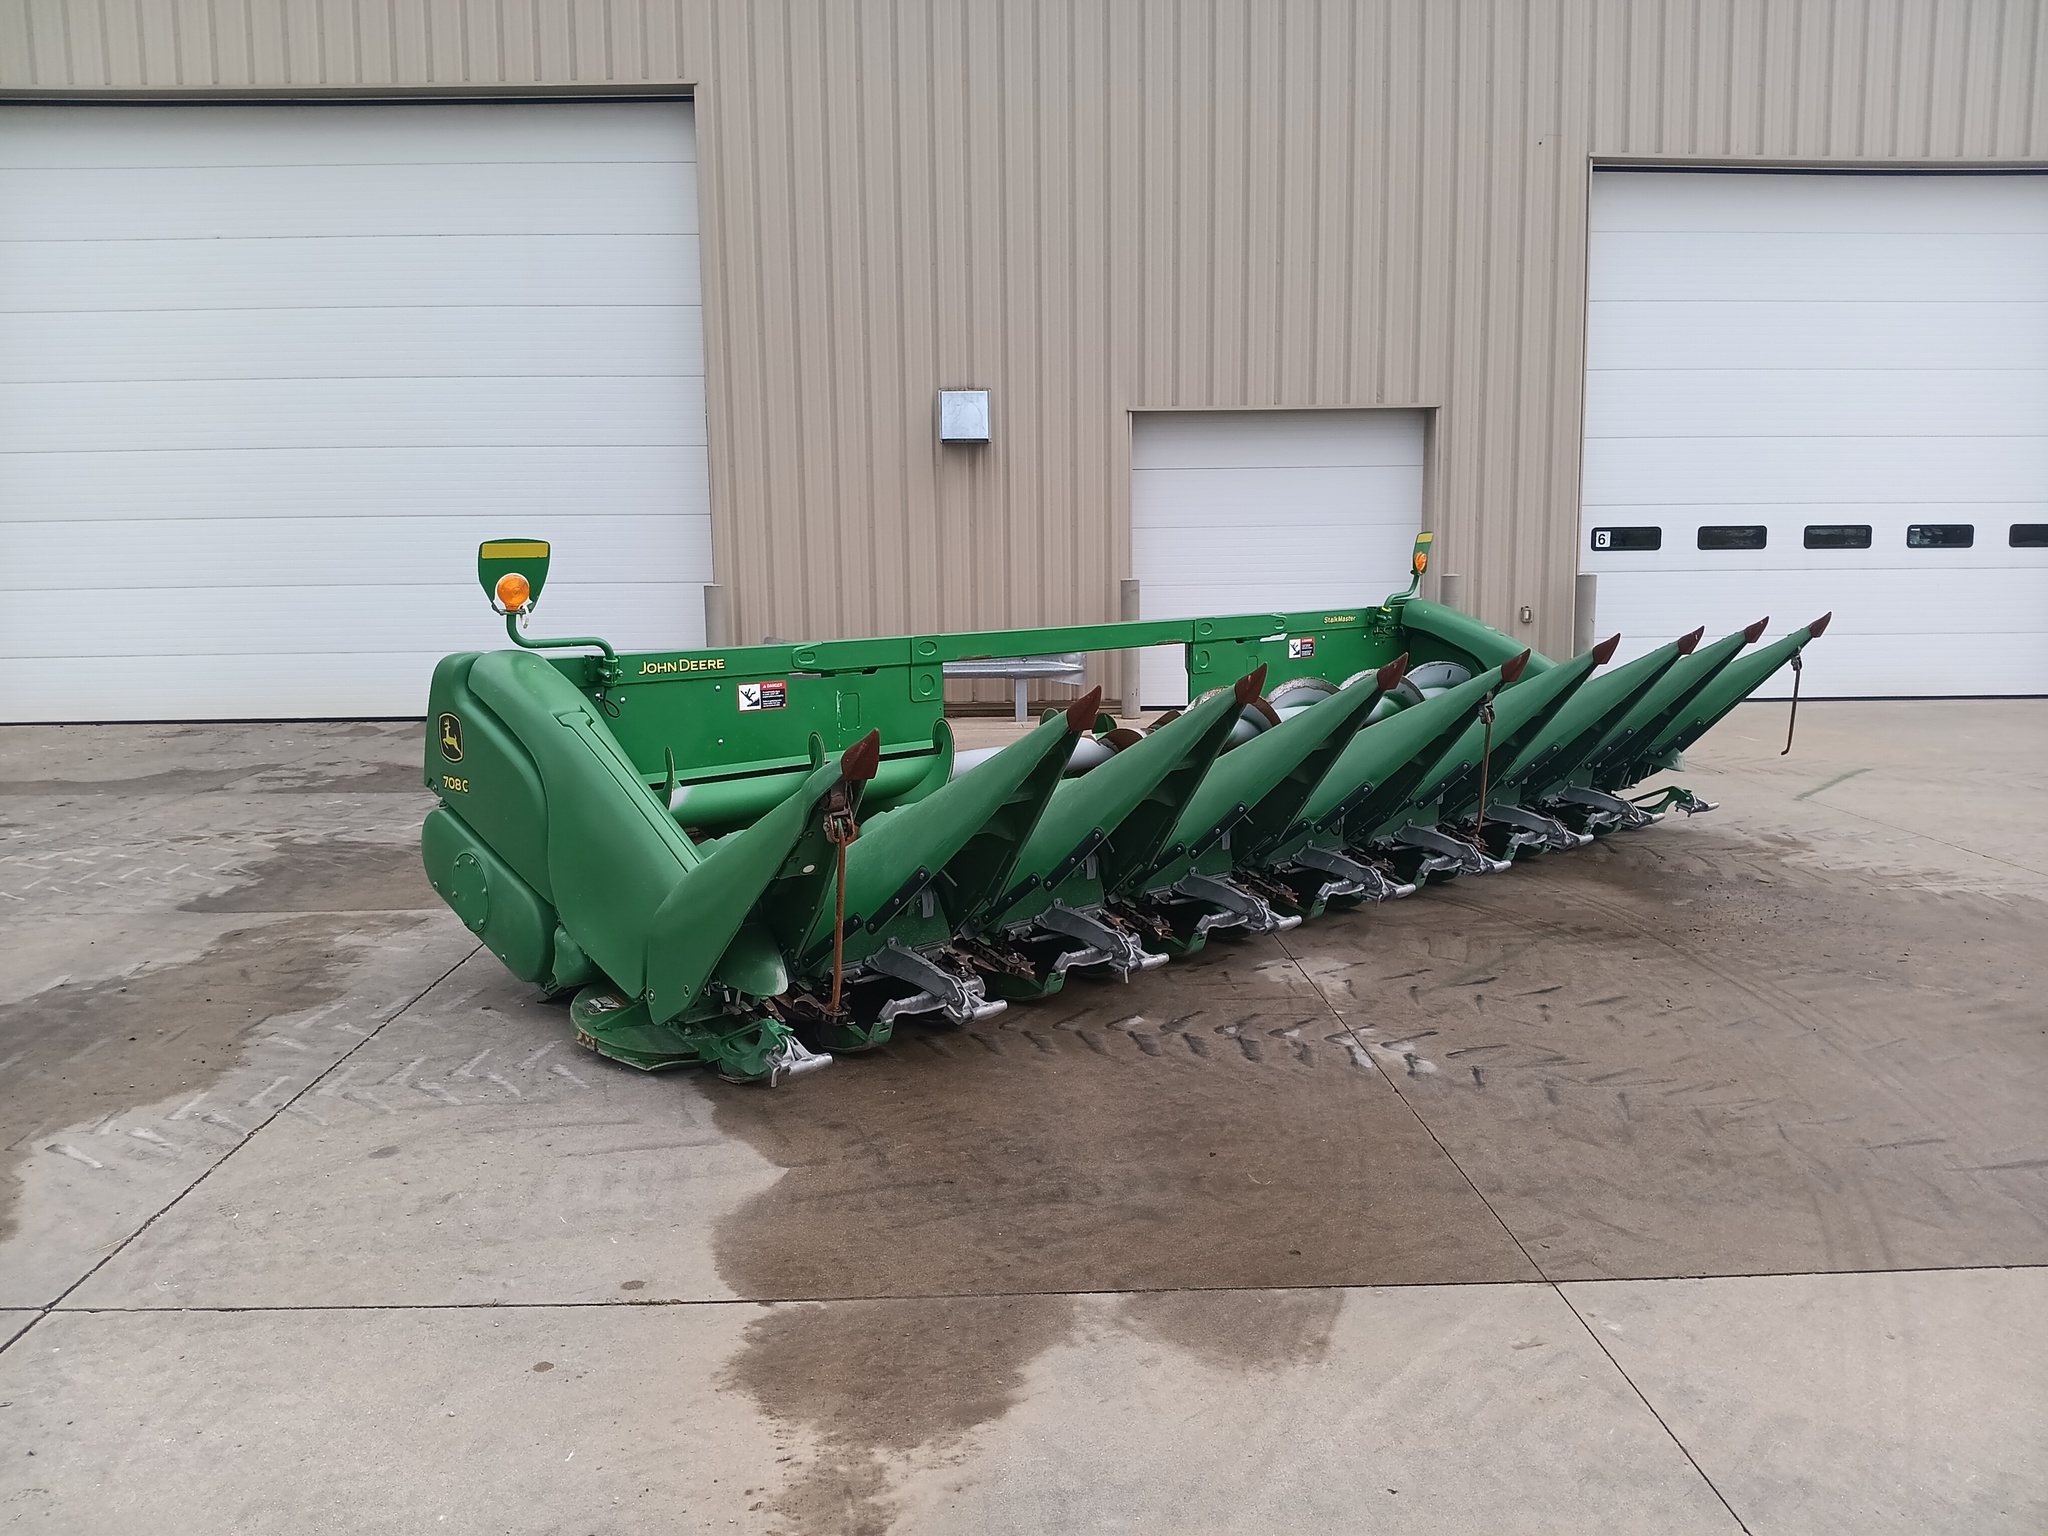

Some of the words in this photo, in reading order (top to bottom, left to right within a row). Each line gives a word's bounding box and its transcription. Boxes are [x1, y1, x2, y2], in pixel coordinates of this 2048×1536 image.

[1598, 533, 1606, 545] 6
[638, 661, 677, 675] JOHN
[679, 658, 725, 672] DEERE
